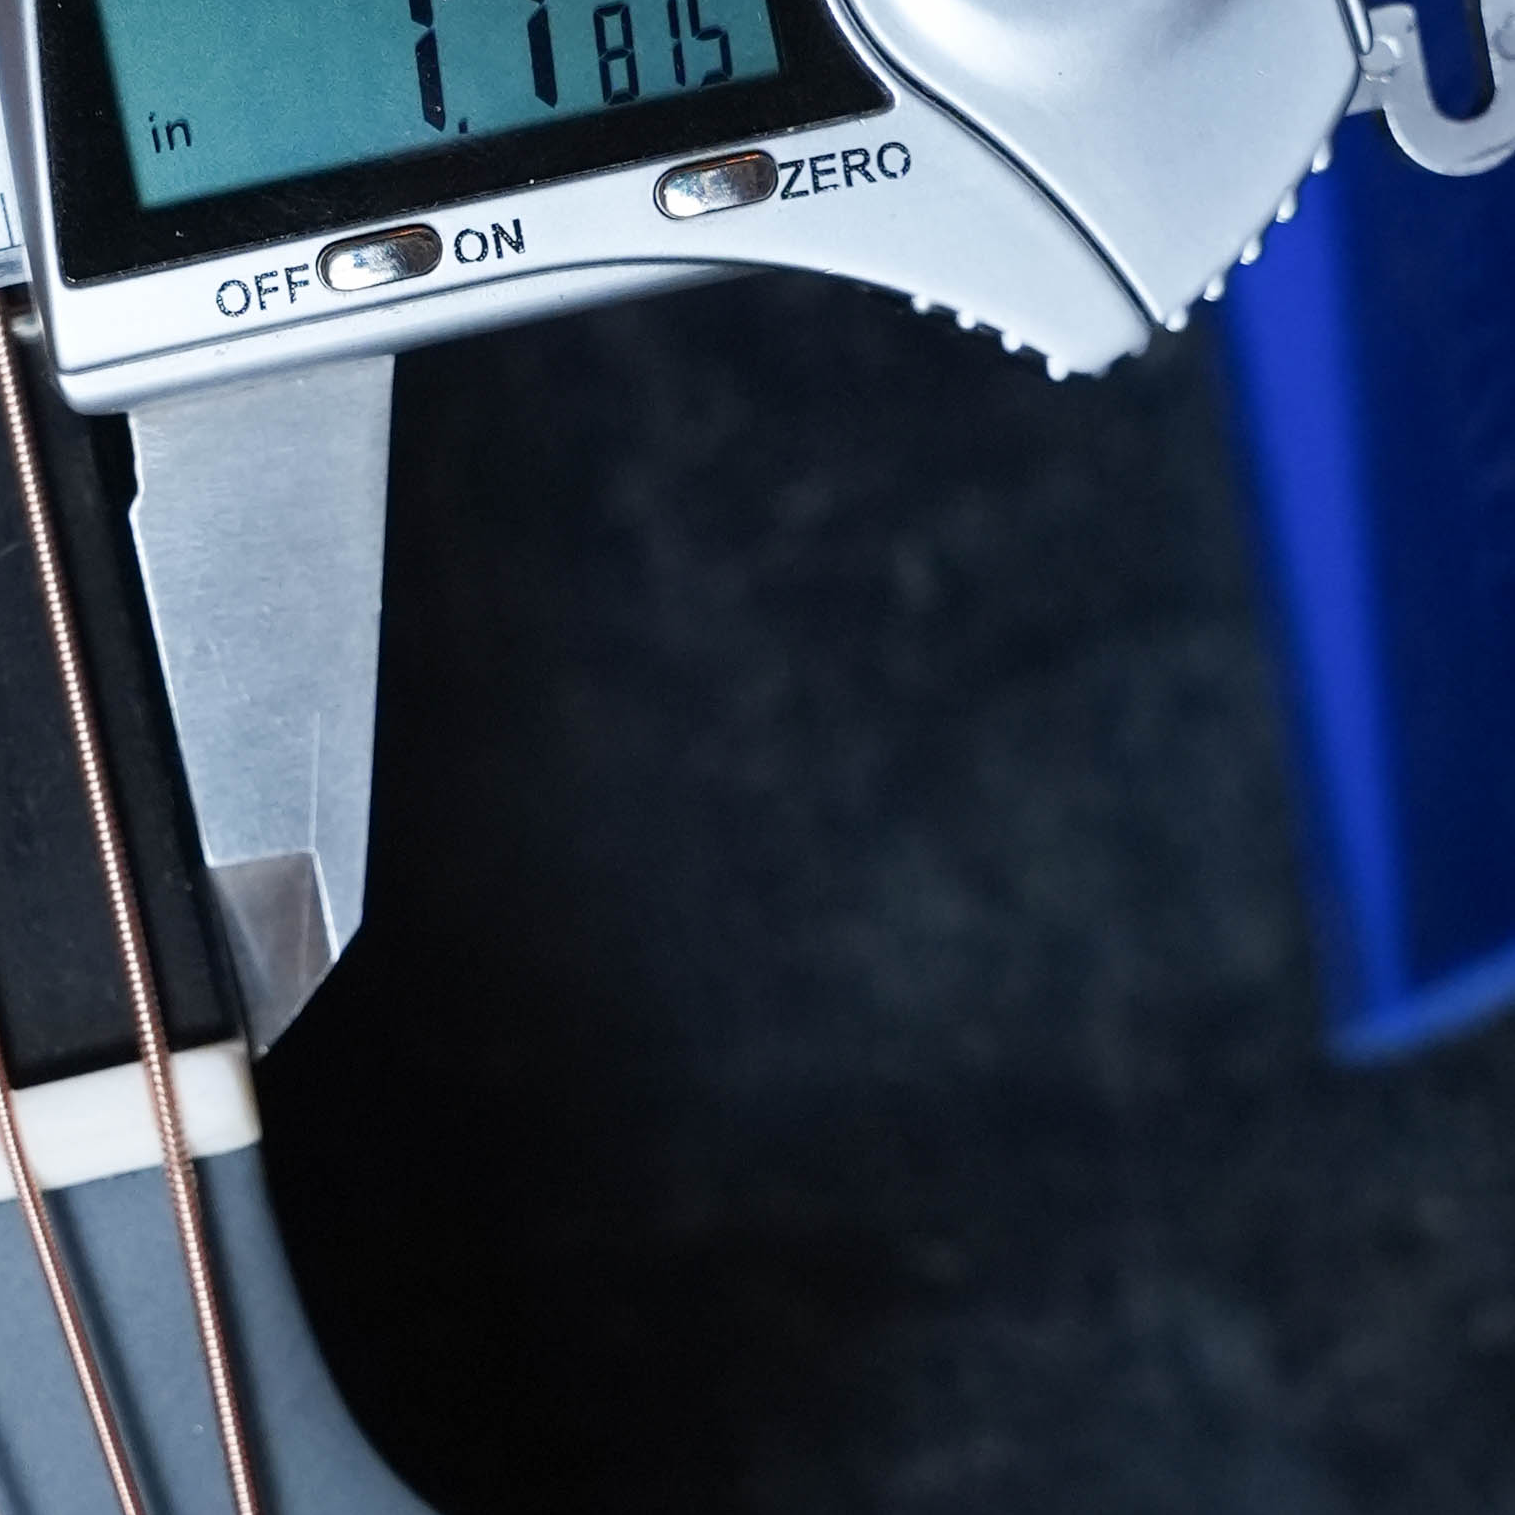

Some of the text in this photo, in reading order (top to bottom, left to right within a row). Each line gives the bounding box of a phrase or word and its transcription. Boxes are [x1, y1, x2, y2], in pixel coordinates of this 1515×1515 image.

[149, 113, 192, 154] in
[778, 141, 912, 201] ZERO
[215, 217, 526, 318] OFF ON
